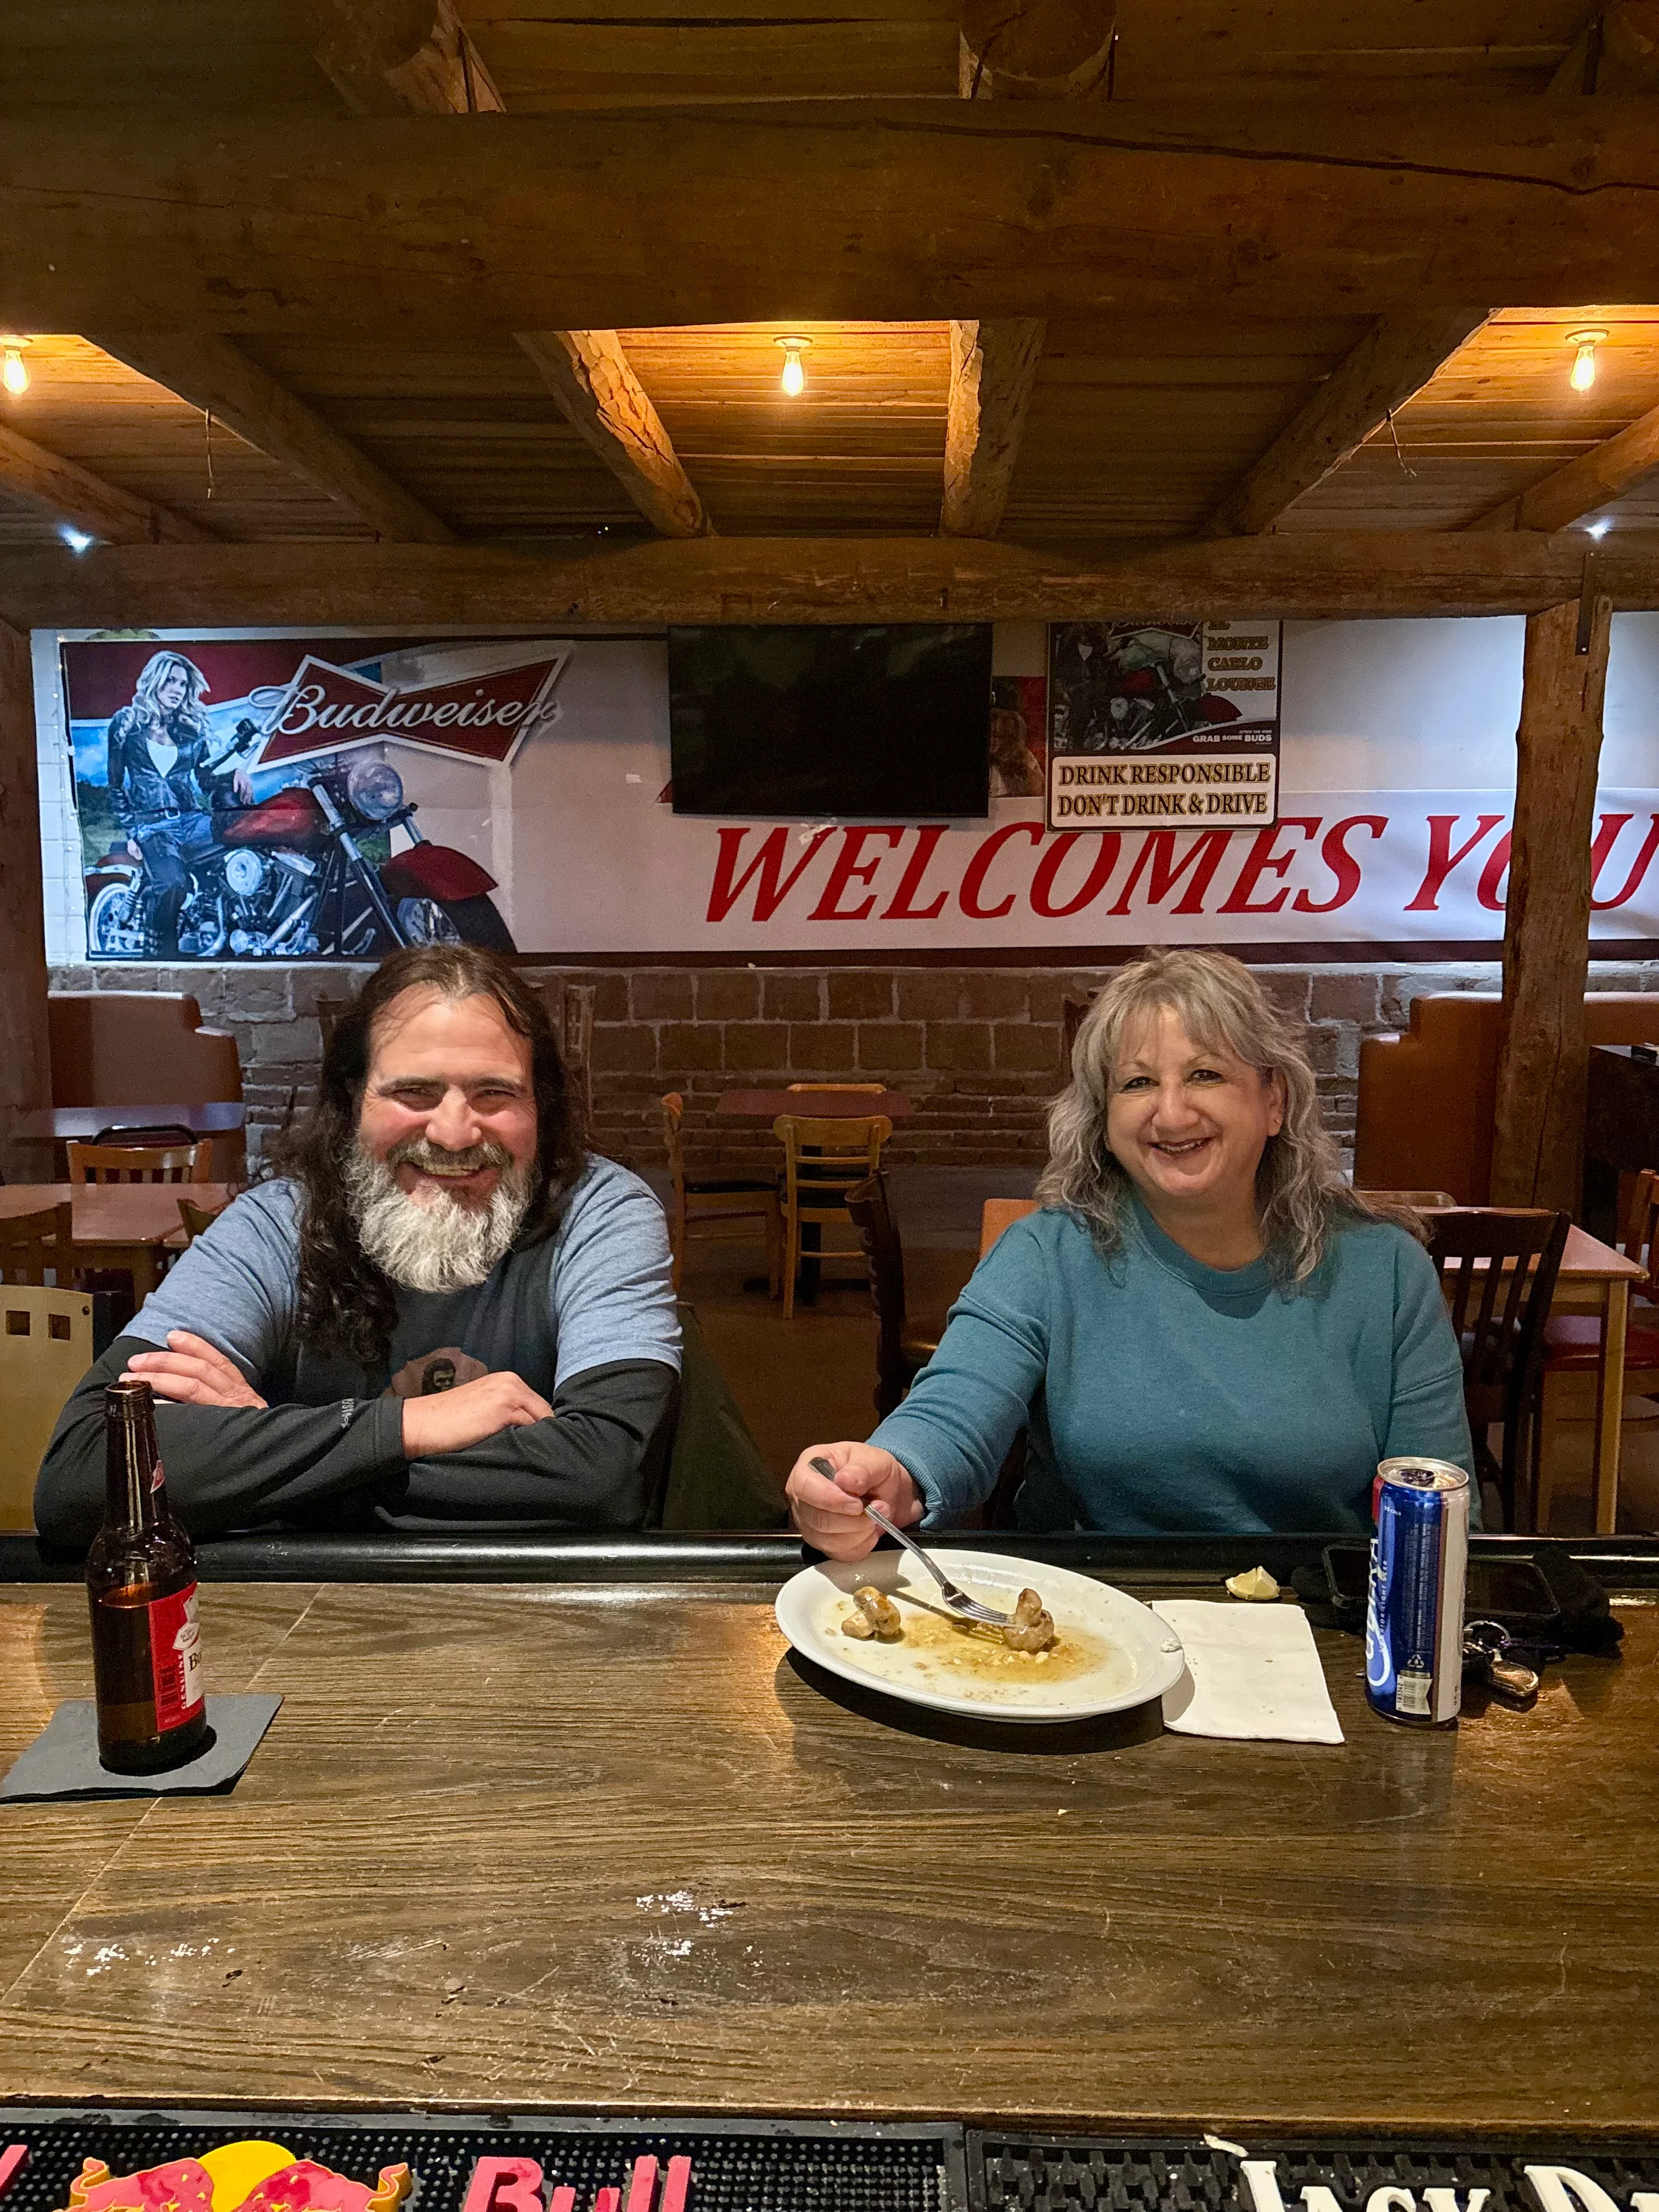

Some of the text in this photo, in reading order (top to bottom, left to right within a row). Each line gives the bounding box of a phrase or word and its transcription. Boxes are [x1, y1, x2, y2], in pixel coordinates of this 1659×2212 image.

[1207, 636, 1268, 651] MONTE
[1207, 657, 1263, 671] CARLO
[1207, 677, 1276, 691] LOUNGE
[248, 684, 563, 735] Budweiser
[1059, 762, 1270, 786] DRINK RESPONSIBLE
[1057, 792, 1267, 817] DON'T DRINK & DRIVE
[705, 815, 1390, 923] WELCOMES
[463, 2155, 692, 2212] Bull
